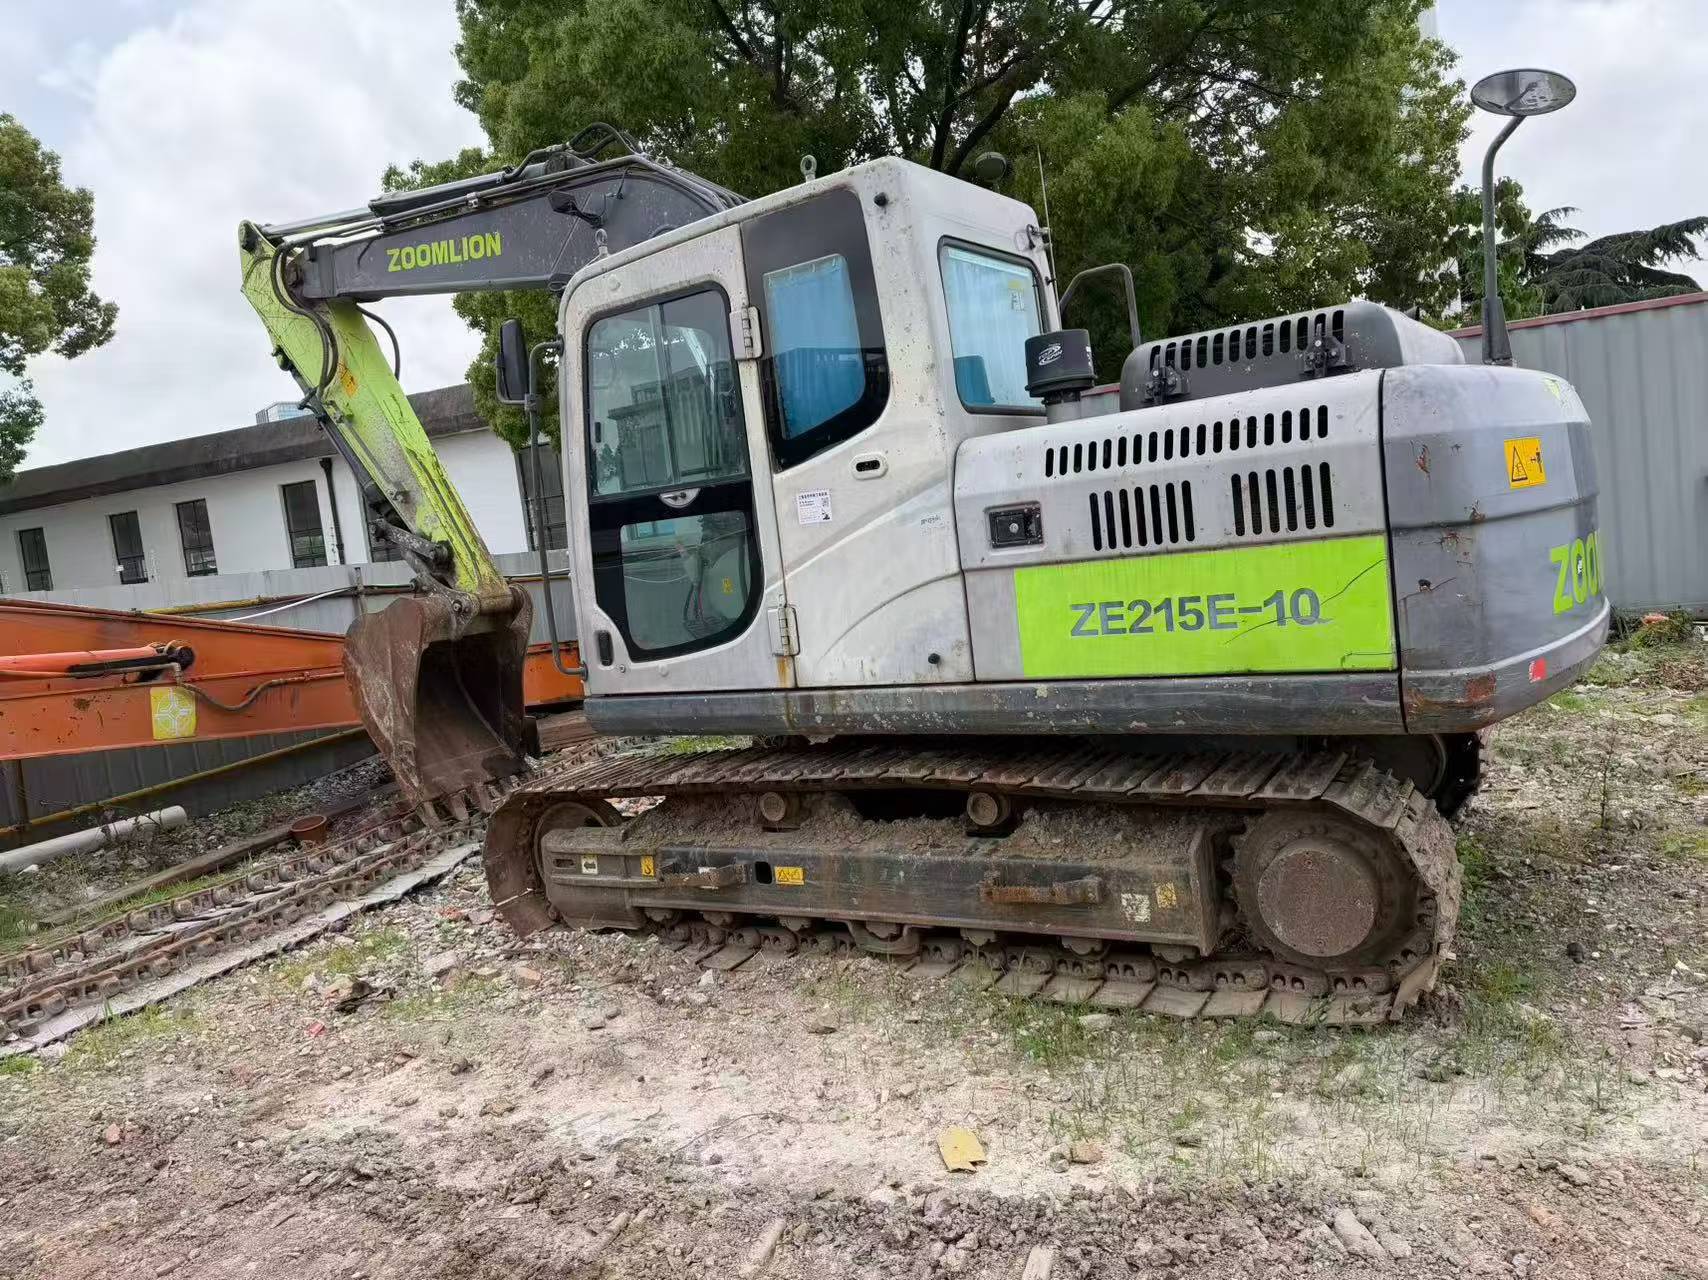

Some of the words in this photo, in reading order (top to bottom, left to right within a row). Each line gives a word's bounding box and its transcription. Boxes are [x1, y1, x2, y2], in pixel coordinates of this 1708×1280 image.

[386, 231, 502, 272] ZOOMLION
[1550, 530, 1602, 615] ZOO
[1070, 587, 1321, 637] ZE215E-10
